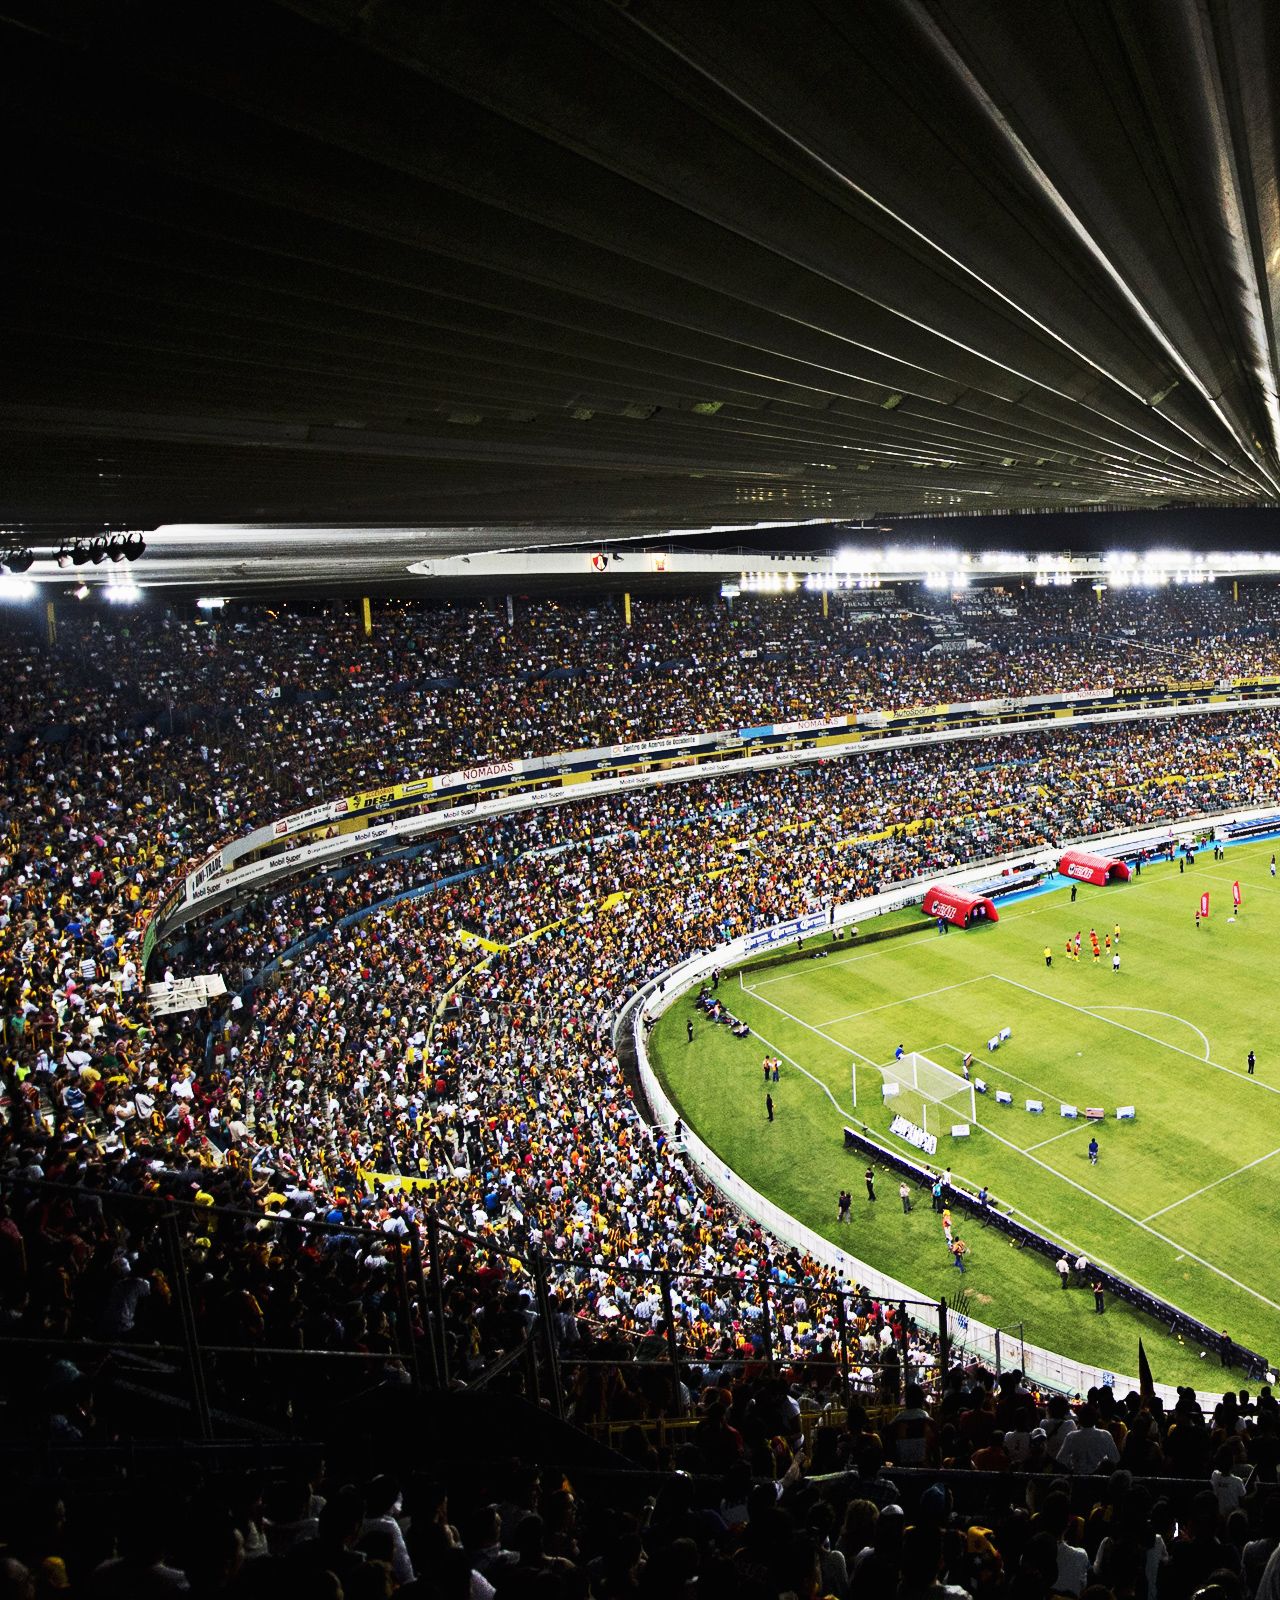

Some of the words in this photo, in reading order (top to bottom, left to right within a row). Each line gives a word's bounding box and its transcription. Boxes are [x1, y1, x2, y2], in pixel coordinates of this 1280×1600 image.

[1114, 686, 1166, 696] PINTURAS
[463, 763, 515, 781] NOMADAS
[620, 777, 636, 785] Mobil
[364, 794, 395, 808] DESA
[532, 793, 548, 801] Mobil
[548, 791, 565, 799] Super
[443, 810, 460, 820] Mobil
[460, 808, 476, 818] Super
[354, 831, 371, 842] Mobil
[371, 828, 388, 840] Super
[270, 856, 286, 868] Mobil
[286, 852, 302, 865] Super
[194, 855, 222, 888] UNI-TRADE
